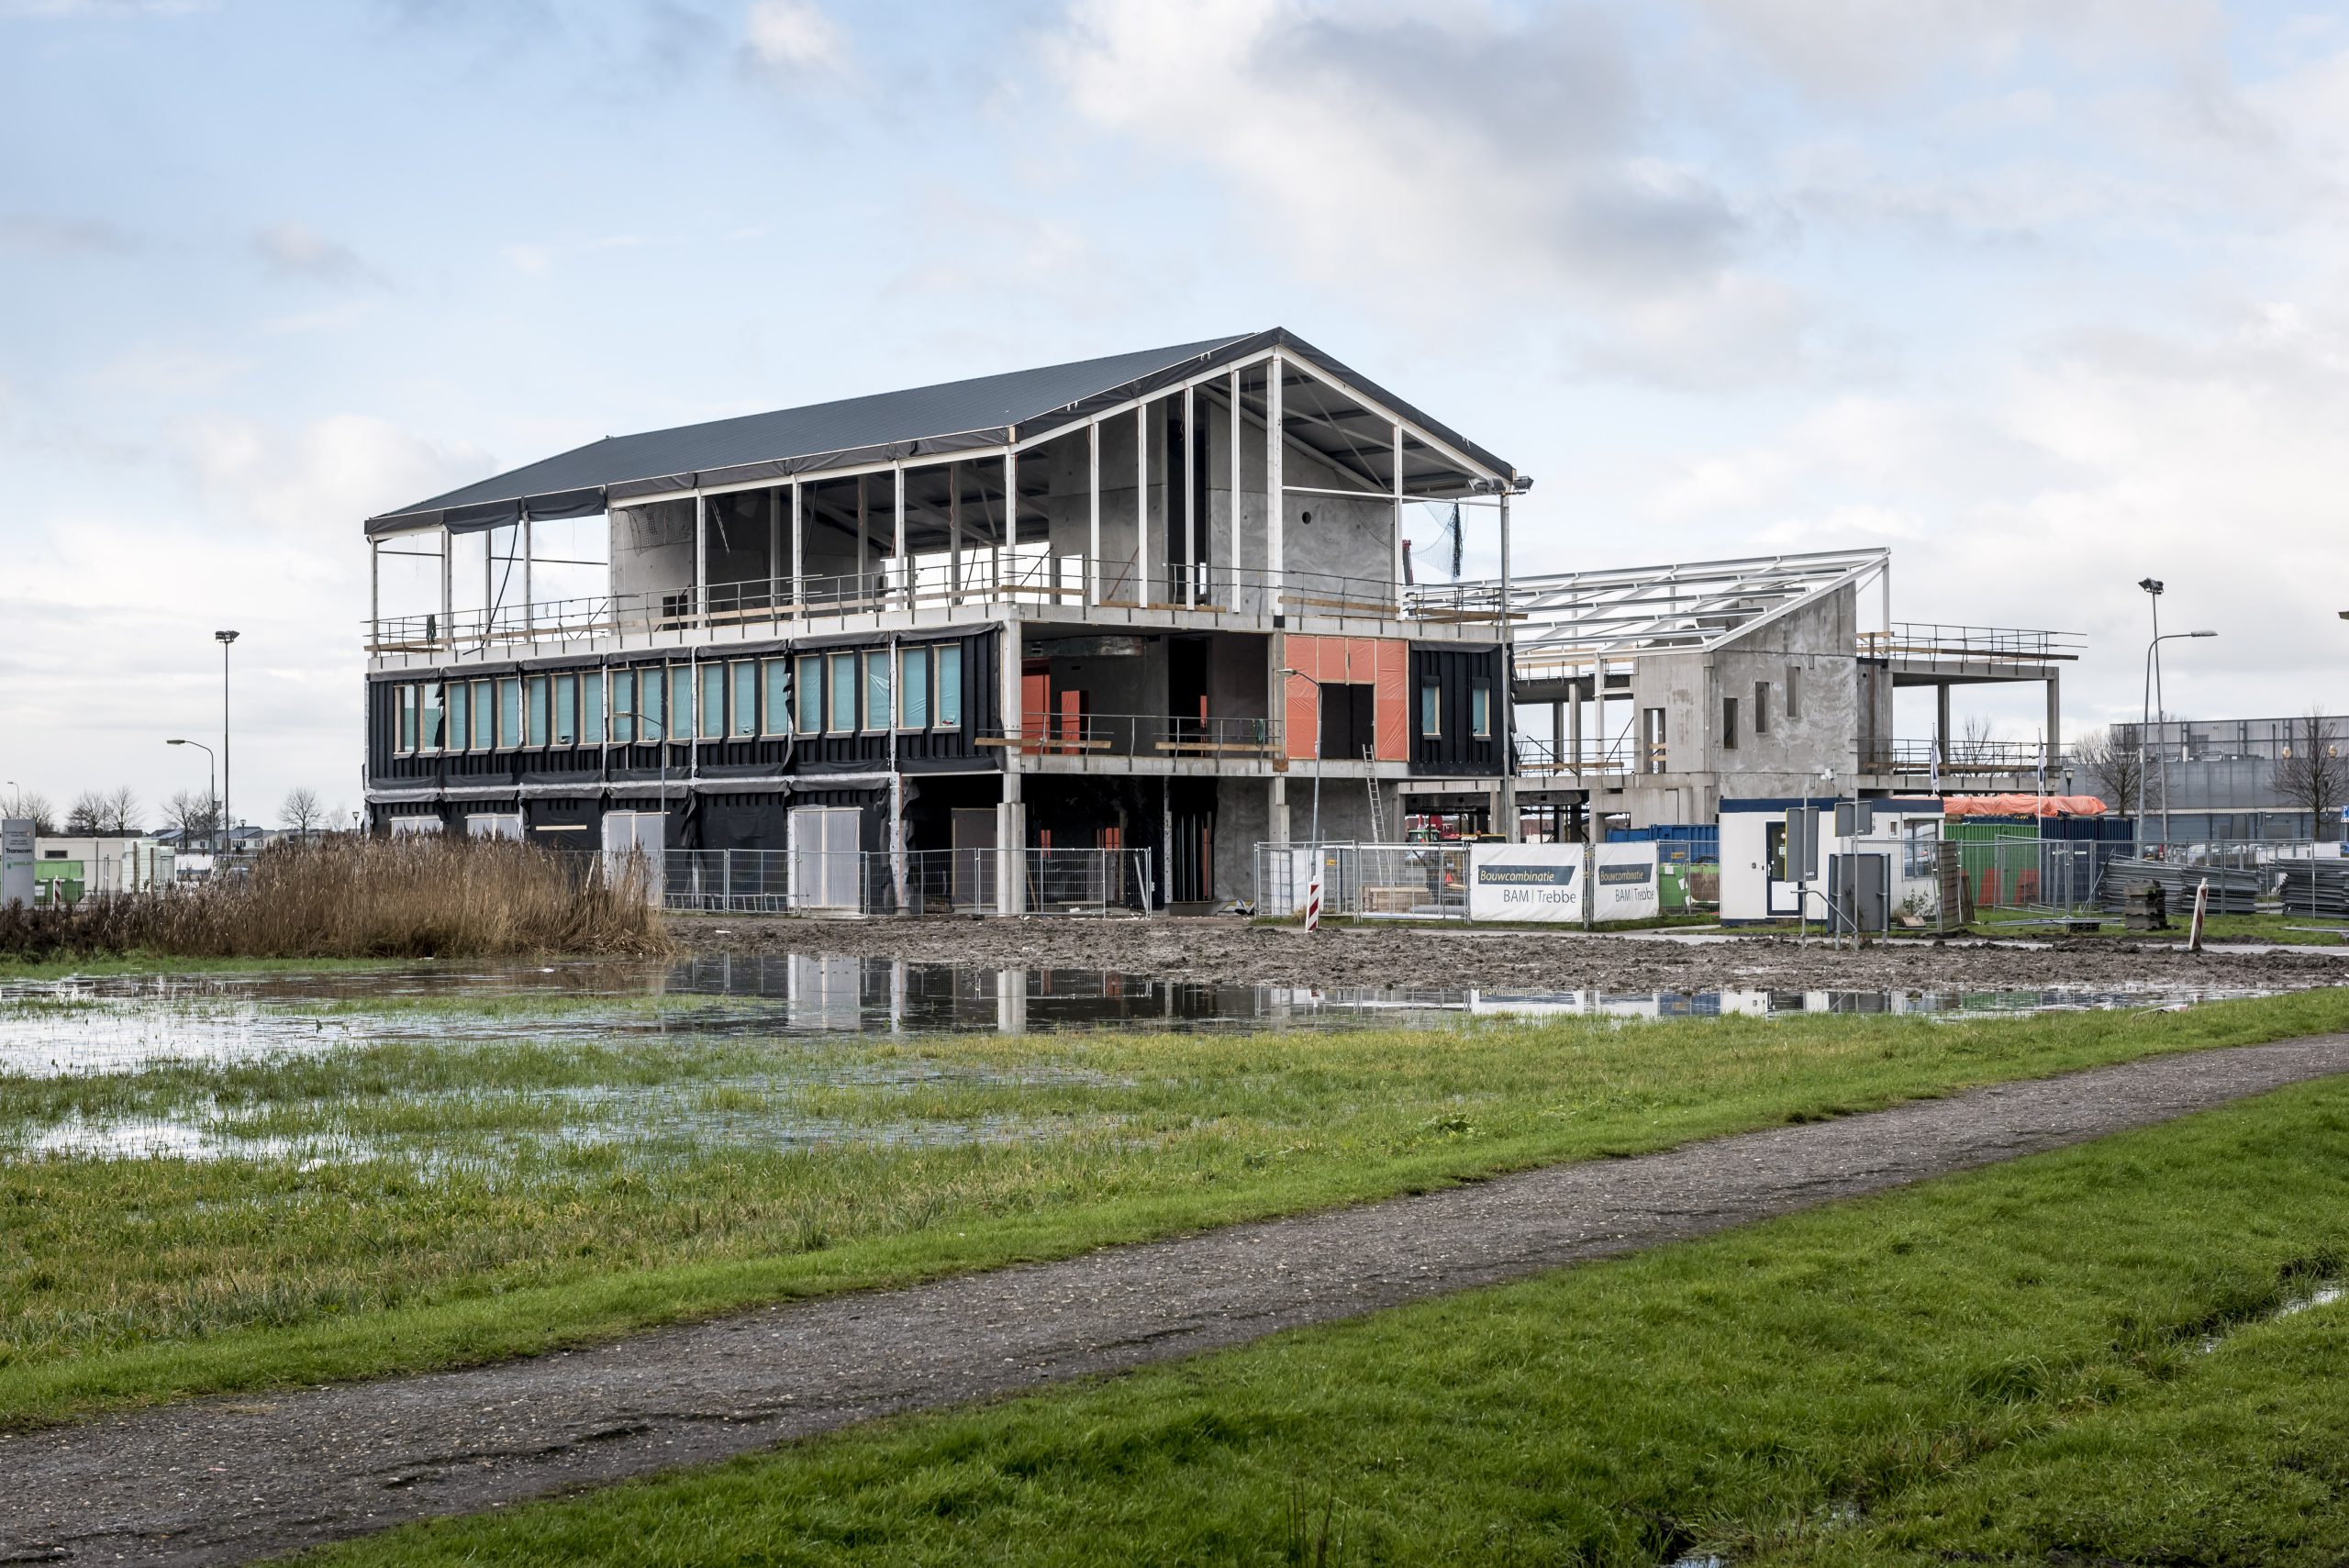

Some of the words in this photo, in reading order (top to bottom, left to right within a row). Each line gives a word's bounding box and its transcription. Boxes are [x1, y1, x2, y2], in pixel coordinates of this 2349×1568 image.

[1480, 870, 1554, 882] Bouwcombinatie
[1600, 869, 1643, 882] Bouwcombinatie
[1503, 889, 1529, 903] BAM
[1537, 889, 1576, 904] Trebbe
[1615, 888, 1631, 903] BAM
[1633, 886, 1654, 901] Trebbe
